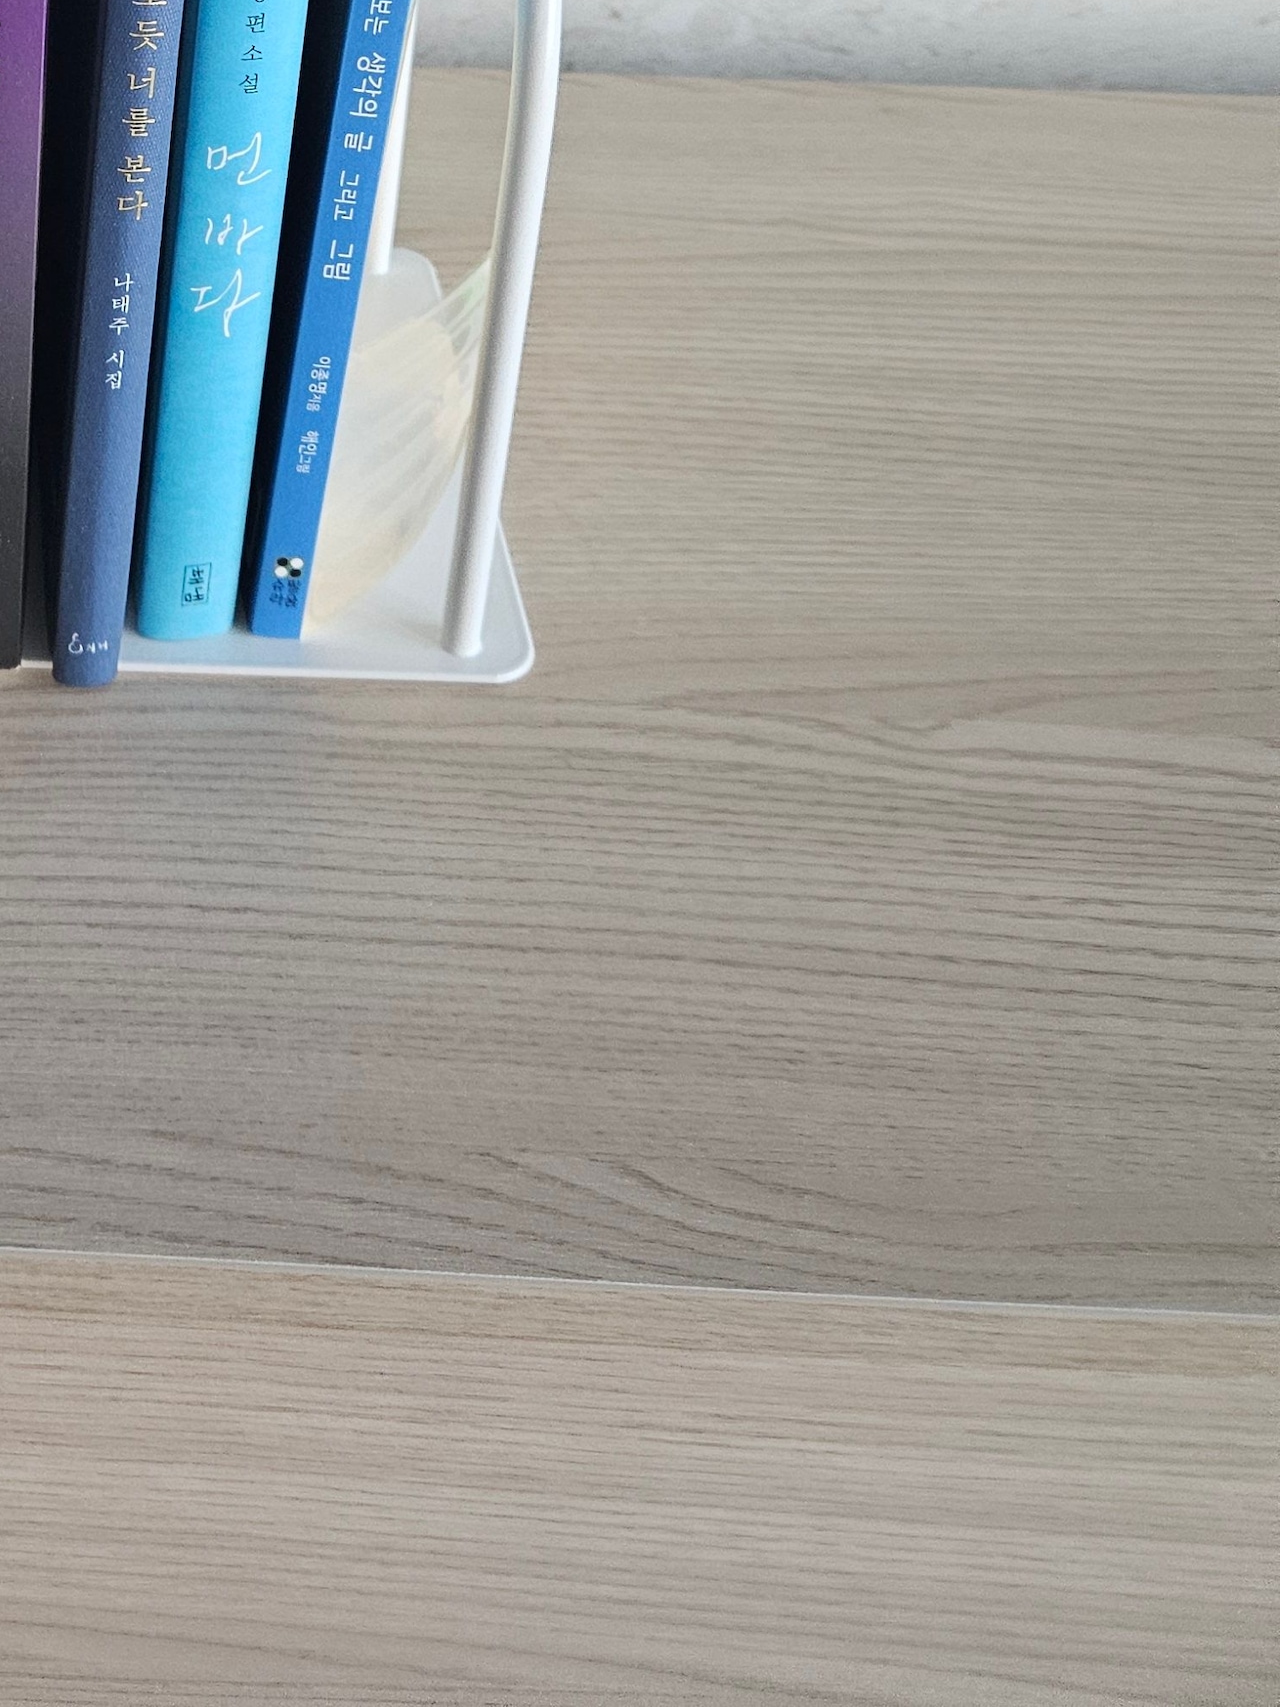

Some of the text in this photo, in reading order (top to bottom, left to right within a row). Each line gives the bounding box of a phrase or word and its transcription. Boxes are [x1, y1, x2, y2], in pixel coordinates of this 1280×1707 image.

[122, 67, 156, 137] 너를
[348, 51, 387, 118] 생각의
[344, 131, 374, 153] 글
[116, 154, 152, 221] 본다
[333, 170, 360, 221] 그리고
[322, 239, 354, 281] 그림
[105, 273, 134, 389] 나태주 시집
